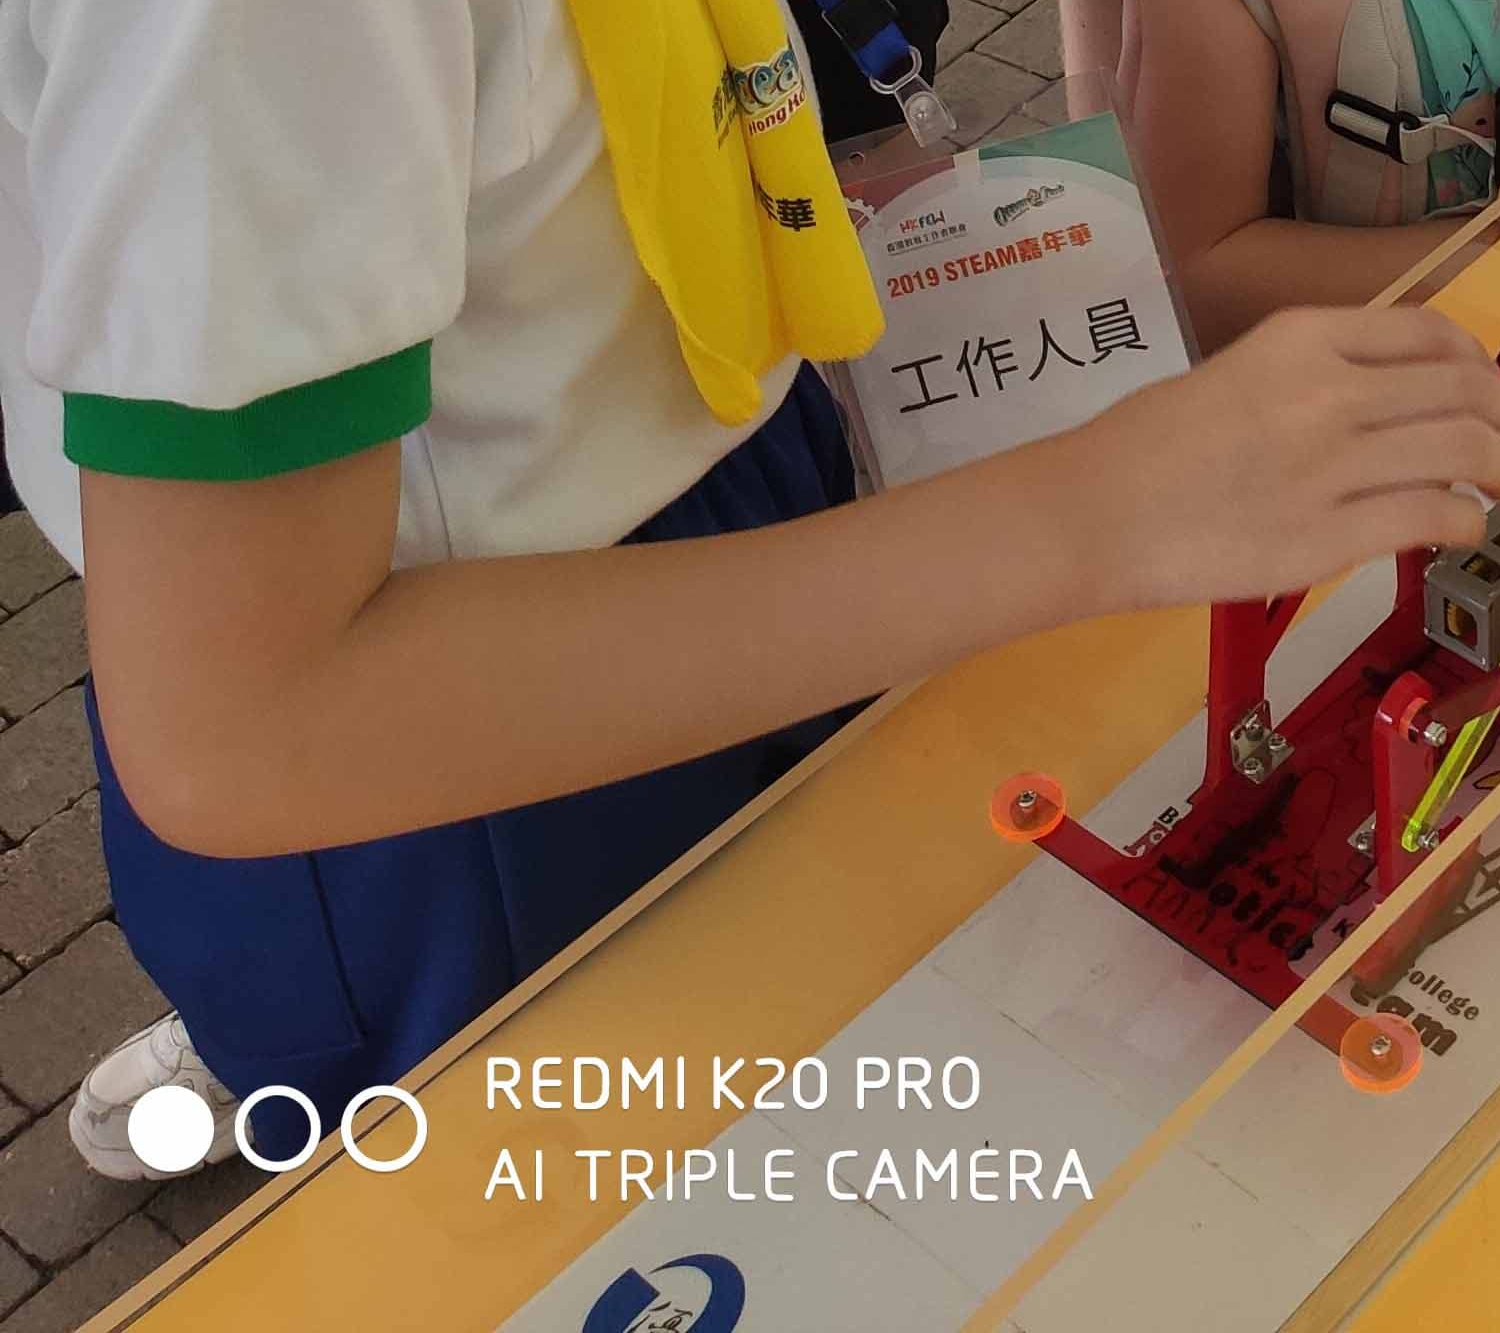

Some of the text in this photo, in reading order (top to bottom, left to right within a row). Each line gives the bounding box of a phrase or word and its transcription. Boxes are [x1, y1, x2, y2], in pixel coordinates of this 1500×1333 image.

[887, 266, 941, 298] 2019
[891, 298, 1149, 414] 工作人員
[1408, 967, 1480, 1021] ollege
